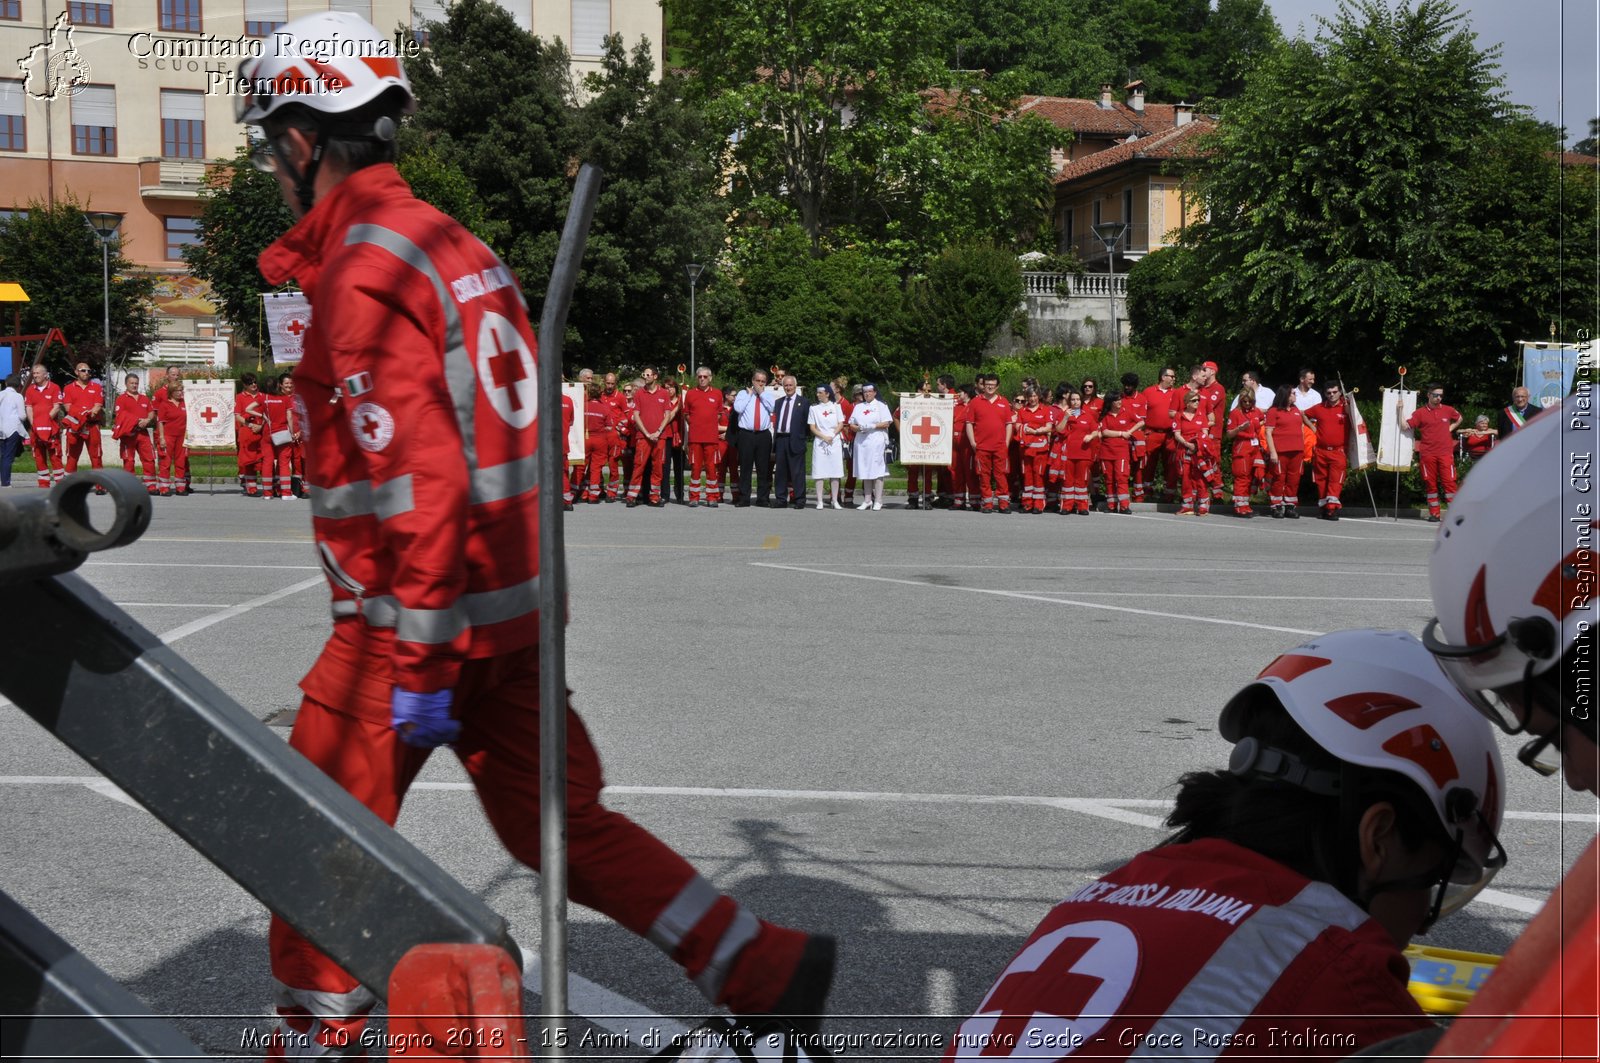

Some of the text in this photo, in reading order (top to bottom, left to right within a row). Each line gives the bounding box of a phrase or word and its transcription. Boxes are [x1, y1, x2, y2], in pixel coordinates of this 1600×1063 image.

[137, 57, 227, 74] SCUOLE
[1098, 883, 1170, 908] ROSSA
[1156, 887, 1253, 926] ITALIANA
